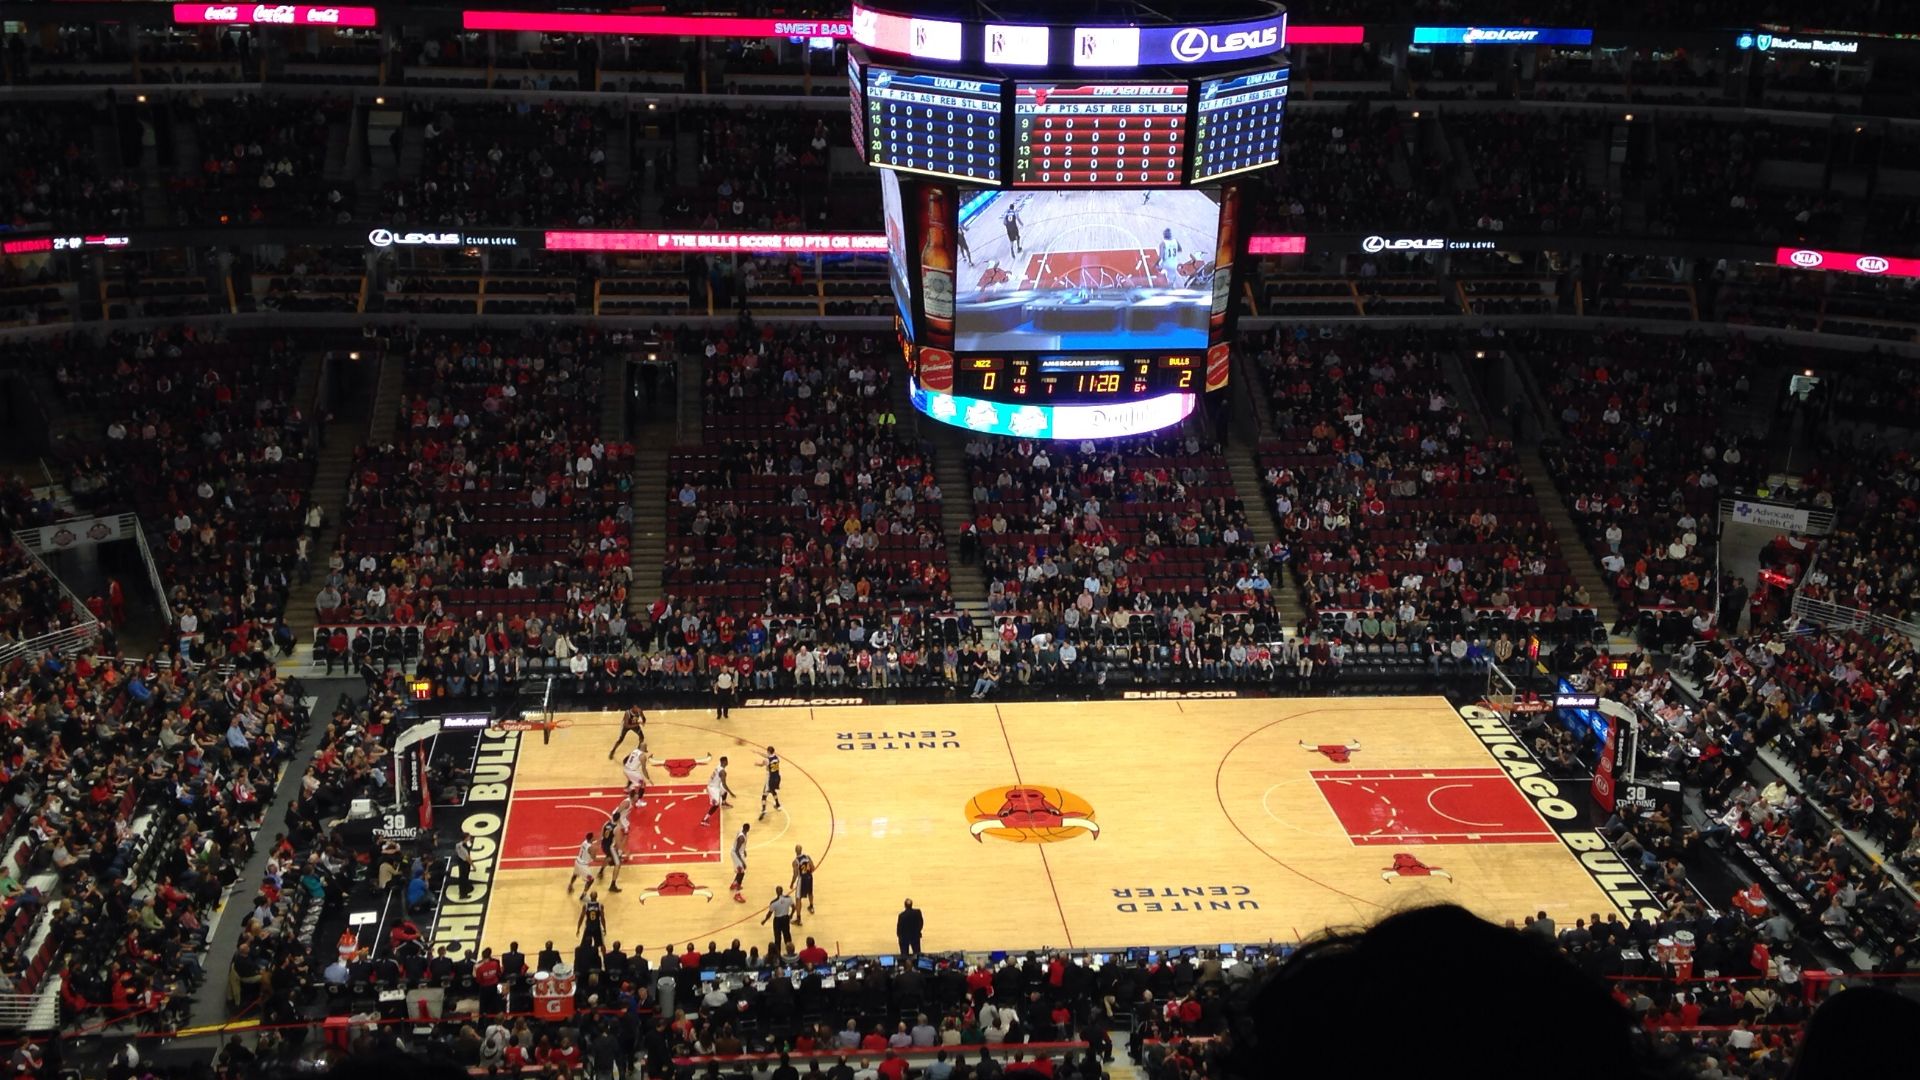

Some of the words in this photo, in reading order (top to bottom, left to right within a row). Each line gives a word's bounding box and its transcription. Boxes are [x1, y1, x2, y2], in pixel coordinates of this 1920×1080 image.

[775, 23, 818, 34] SWEET
[1211, 27, 1277, 53] LEXUS
[1470, 29, 1496, 40] BUD
[1498, 30, 1538, 41] LIGHT
[1772, 38, 1812, 50] BlueCross
[1812, 40, 1858, 52] BlueShield
[935, 78, 957, 88] UTAH
[958, 81, 981, 91] JAZZ
[869, 88, 883, 97] PLY
[940, 97, 956, 105] REB
[962, 99, 976, 108] STL
[982, 102, 998, 110] BLK
[871, 101, 880, 111] 24
[890, 104, 896, 113] 0
[906, 106, 912, 116] 0
[926, 108, 933, 118] 0
[947, 111, 953, 121] 0
[967, 113, 973, 124] 0
[988, 116, 994, 126] 0
[872, 114, 881, 124] 15
[890, 117, 896, 126] 0
[906, 119, 912, 129] 0
[927, 122, 933, 132] 0
[947, 124, 954, 134] 0
[967, 127, 974, 137] 0
[988, 130, 995, 140] 0
[1022, 118, 1029, 128] 9
[1045, 118, 1052, 128] 0
[1066, 118, 1073, 128] 0
[1094, 118, 1099, 128] 1
[1119, 118, 1126, 128] 0
[1144, 118, 1152, 128] 0
[1171, 118, 1178, 128] 0
[874, 127, 880, 137] 0
[891, 130, 897, 140] 0
[907, 132, 913, 142] 0
[927, 135, 933, 144] 0
[948, 138, 954, 148] 0
[967, 140, 974, 150] 0
[988, 143, 995, 153] 0
[1021, 132, 1028, 142] 5
[1044, 132, 1052, 142] 0
[1065, 132, 1073, 142] 0
[1092, 132, 1099, 142] 0
[1118, 132, 1126, 142] 0
[1143, 132, 1151, 142] 0
[1170, 132, 1177, 141] 0
[872, 140, 882, 150] 20
[891, 143, 897, 153] 0
[907, 145, 913, 155] 0
[927, 148, 933, 158] 0
[948, 151, 954, 161] 0
[967, 154, 974, 164] 0
[988, 157, 995, 166] 0
[1019, 146, 1030, 155] 13
[1044, 146, 1051, 155] 0
[1065, 146, 1072, 155] 2
[1091, 145, 1099, 155] 0
[1118, 145, 1125, 155] 0
[1142, 145, 1150, 155] 0
[1168, 145, 1176, 155] 0
[1017, 159, 1029, 169] 21
[1043, 159, 1050, 169] 0
[1064, 159, 1071, 169] 0
[1090, 159, 1098, 169] 0
[1117, 159, 1124, 169] 0
[1142, 158, 1149, 168] 0
[1168, 158, 1175, 168] 0
[1021, 173, 1026, 182] 1
[1042, 172, 1050, 182] 0
[1064, 172, 1071, 182] 0
[1090, 172, 1097, 182] 0
[1116, 172, 1123, 182] 0
[1141, 172, 1148, 182] 0
[1167, 172, 1174, 181] 0
[394, 233, 460, 244] LEXUS
[672, 236, 696, 246] THE
[698, 236, 737, 246] BULLS
[740, 235, 781, 247] SCORE
[805, 236, 829, 247] PTS
[832, 236, 849, 247] OR
[852, 237, 888, 248] MORE
[1385, 239, 1444, 249] LEXUS
[1167, 248, 1177, 258] 13
[1020, 366, 1027, 376] 0
[1141, 365, 1148, 374] 0
[983, 372, 996, 390] 0
[1078, 375, 1120, 392] 11:28
[1179, 370, 1192, 387] 2
[1754, 508, 1794, 519] Advocate
[1752, 517, 1781, 528] Health
[1782, 520, 1803, 529] Care
[417, 690, 426, 698] 11
[745, 697, 863, 706] Bulls.com
[1556, 697, 1596, 706] Bulls.com
[444, 718, 487, 726] Bulls.com
[836, 730, 957, 739] CENTER
[837, 741, 960, 750] UNITED
[1460, 704, 1577, 820] CHICAGO
[1626, 787, 1646, 800] 30
[383, 814, 405, 829] 30
[1112, 886, 1250, 898] CENTER
[1117, 900, 1259, 912] UNITED
